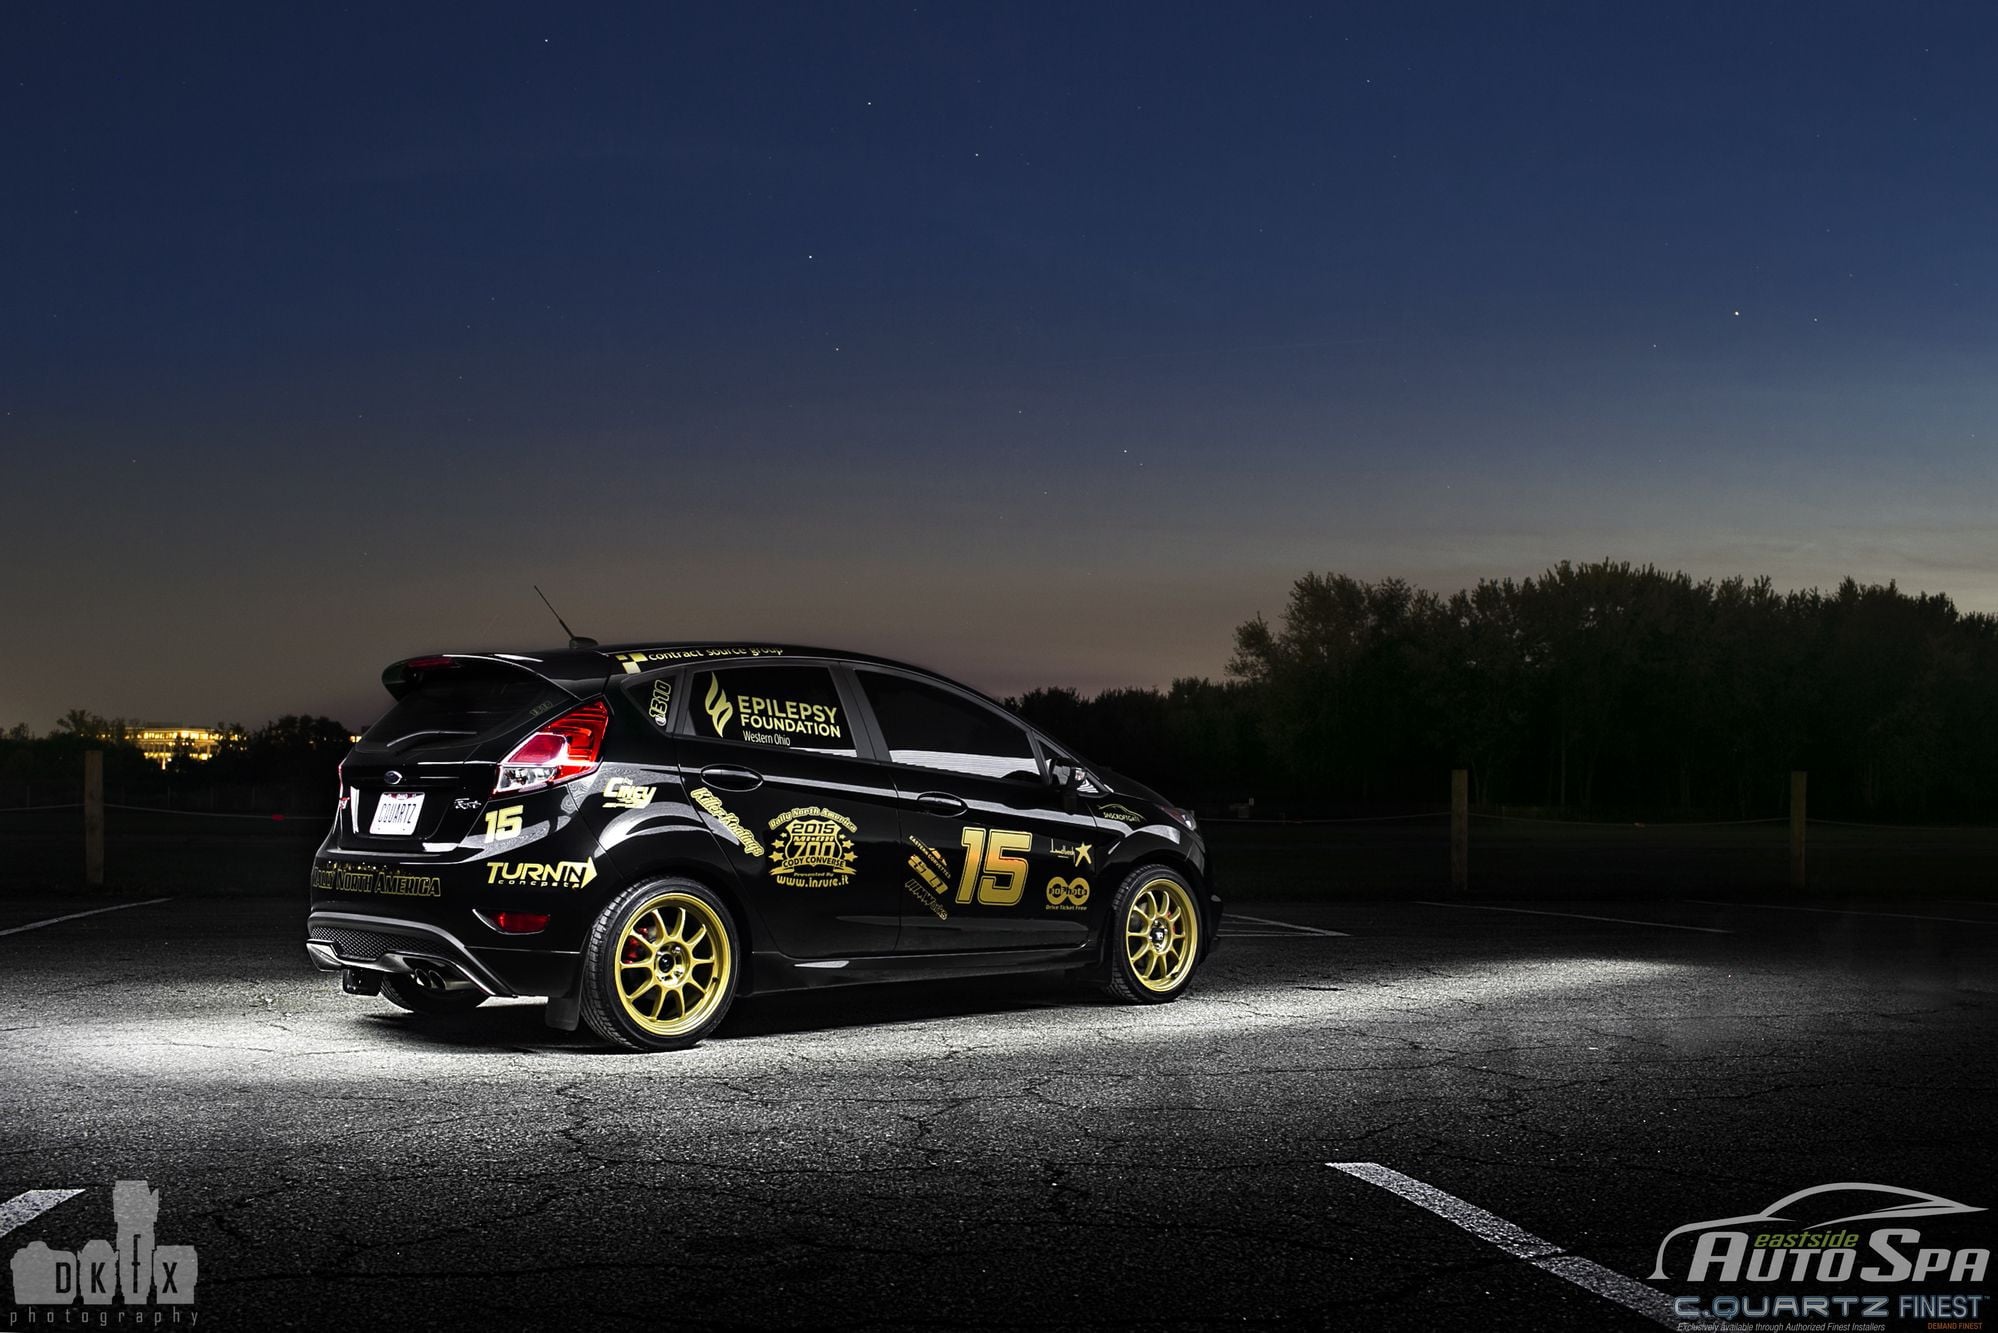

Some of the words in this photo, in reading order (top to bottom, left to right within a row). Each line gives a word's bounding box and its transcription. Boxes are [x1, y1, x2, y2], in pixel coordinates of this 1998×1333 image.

[648, 649, 704, 661] contract
[707, 648, 747, 656] source
[737, 695, 837, 723] EPILEPSY
[740, 714, 841, 738] FOUNDATION
[743, 730, 773, 744] Western
[774, 733, 791, 746] Ohio
[484, 804, 524, 844] 15
[791, 823, 835, 834] 2015
[793, 841, 836, 859] 700
[783, 857, 805, 868] CODY
[806, 856, 845, 867] CONVERSE
[955, 826, 1033, 906] 15
[335, 868, 374, 893] NORTH
[374, 871, 441, 897] AMERICA
[776, 875, 849, 888] www.insure.it
